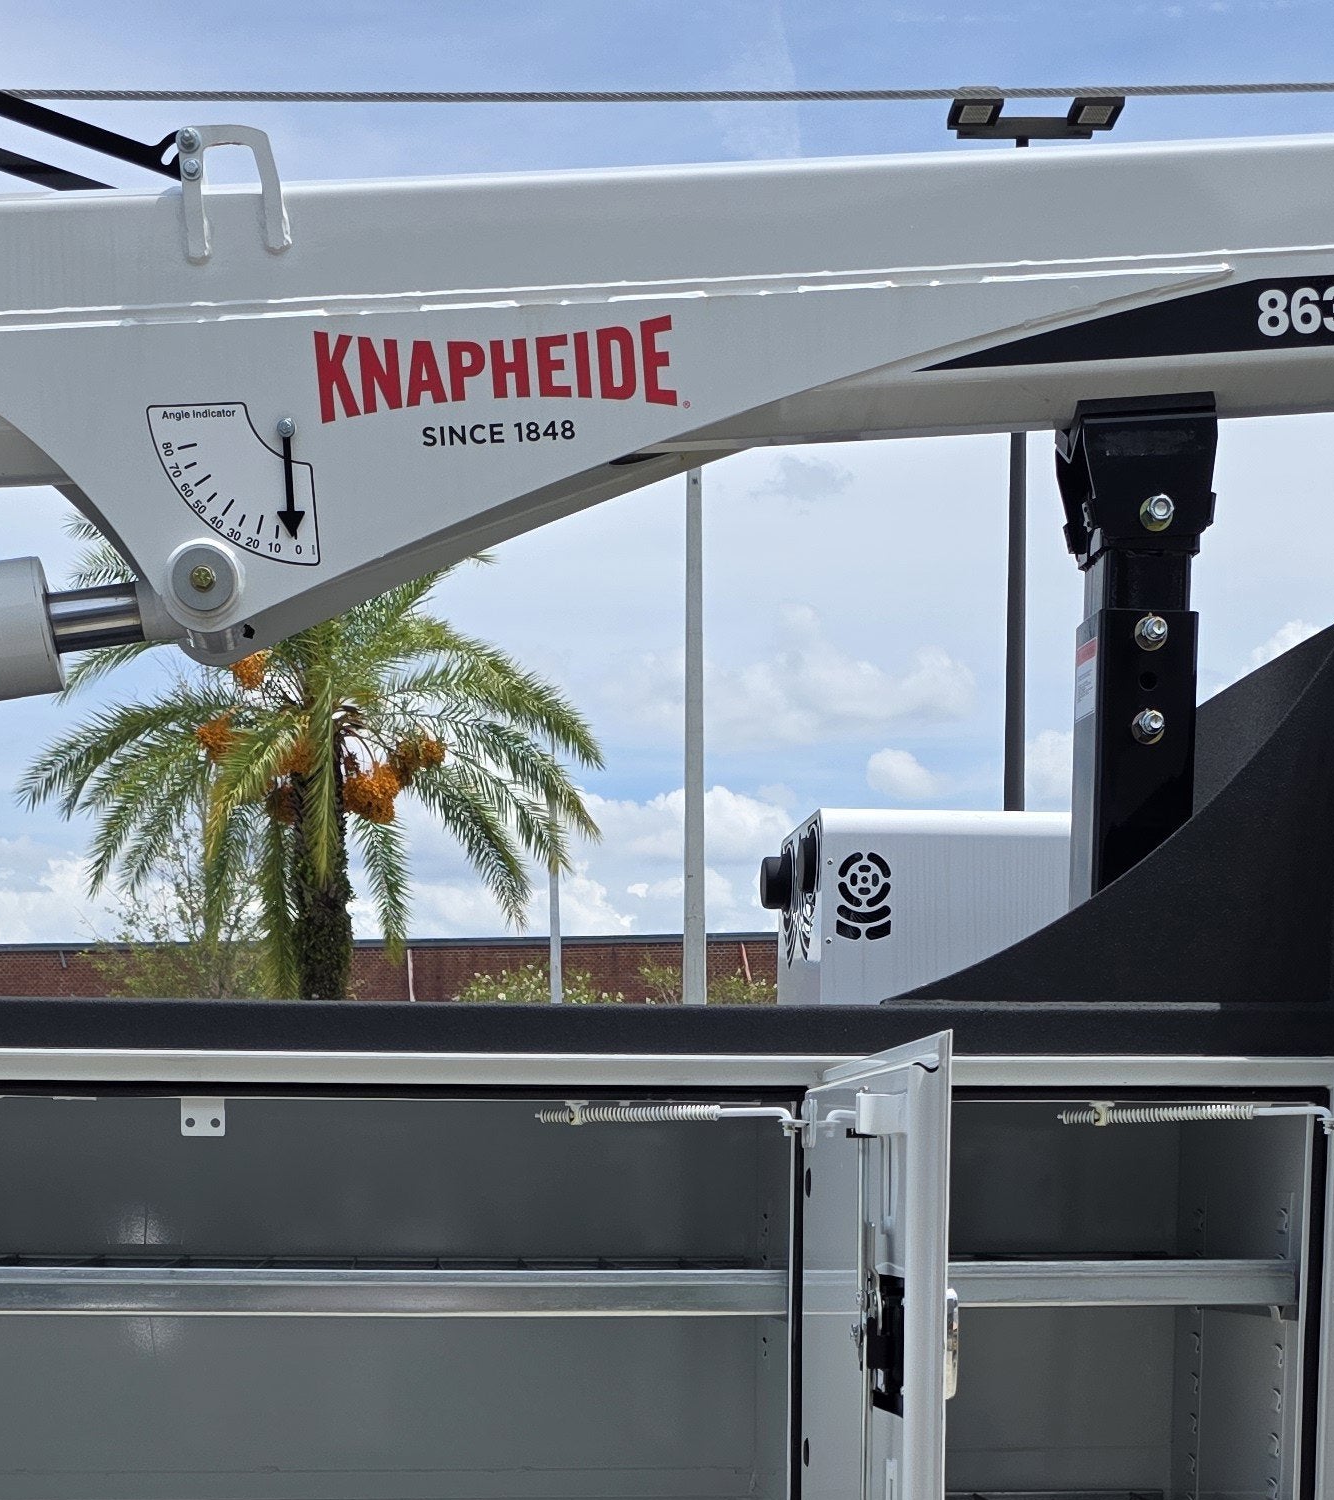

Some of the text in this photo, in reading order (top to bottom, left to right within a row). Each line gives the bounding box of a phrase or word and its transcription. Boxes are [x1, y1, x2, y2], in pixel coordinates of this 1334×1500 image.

[313, 314, 678, 424] KNAPHEIDE
[161, 409, 237, 422] Angle Indicator
[422, 419, 577, 448] SINCE 1848
[161, 441, 175, 457] 80
[168, 462, 183, 478] 70
[180, 482, 194, 499] 60
[192, 499, 207, 515] 50
[209, 515, 224, 530] 40
[226, 527, 242, 542] 30
[245, 537, 260, 550] 20
[268, 542, 282, 554] 10
[295, 544, 303, 555] 0
